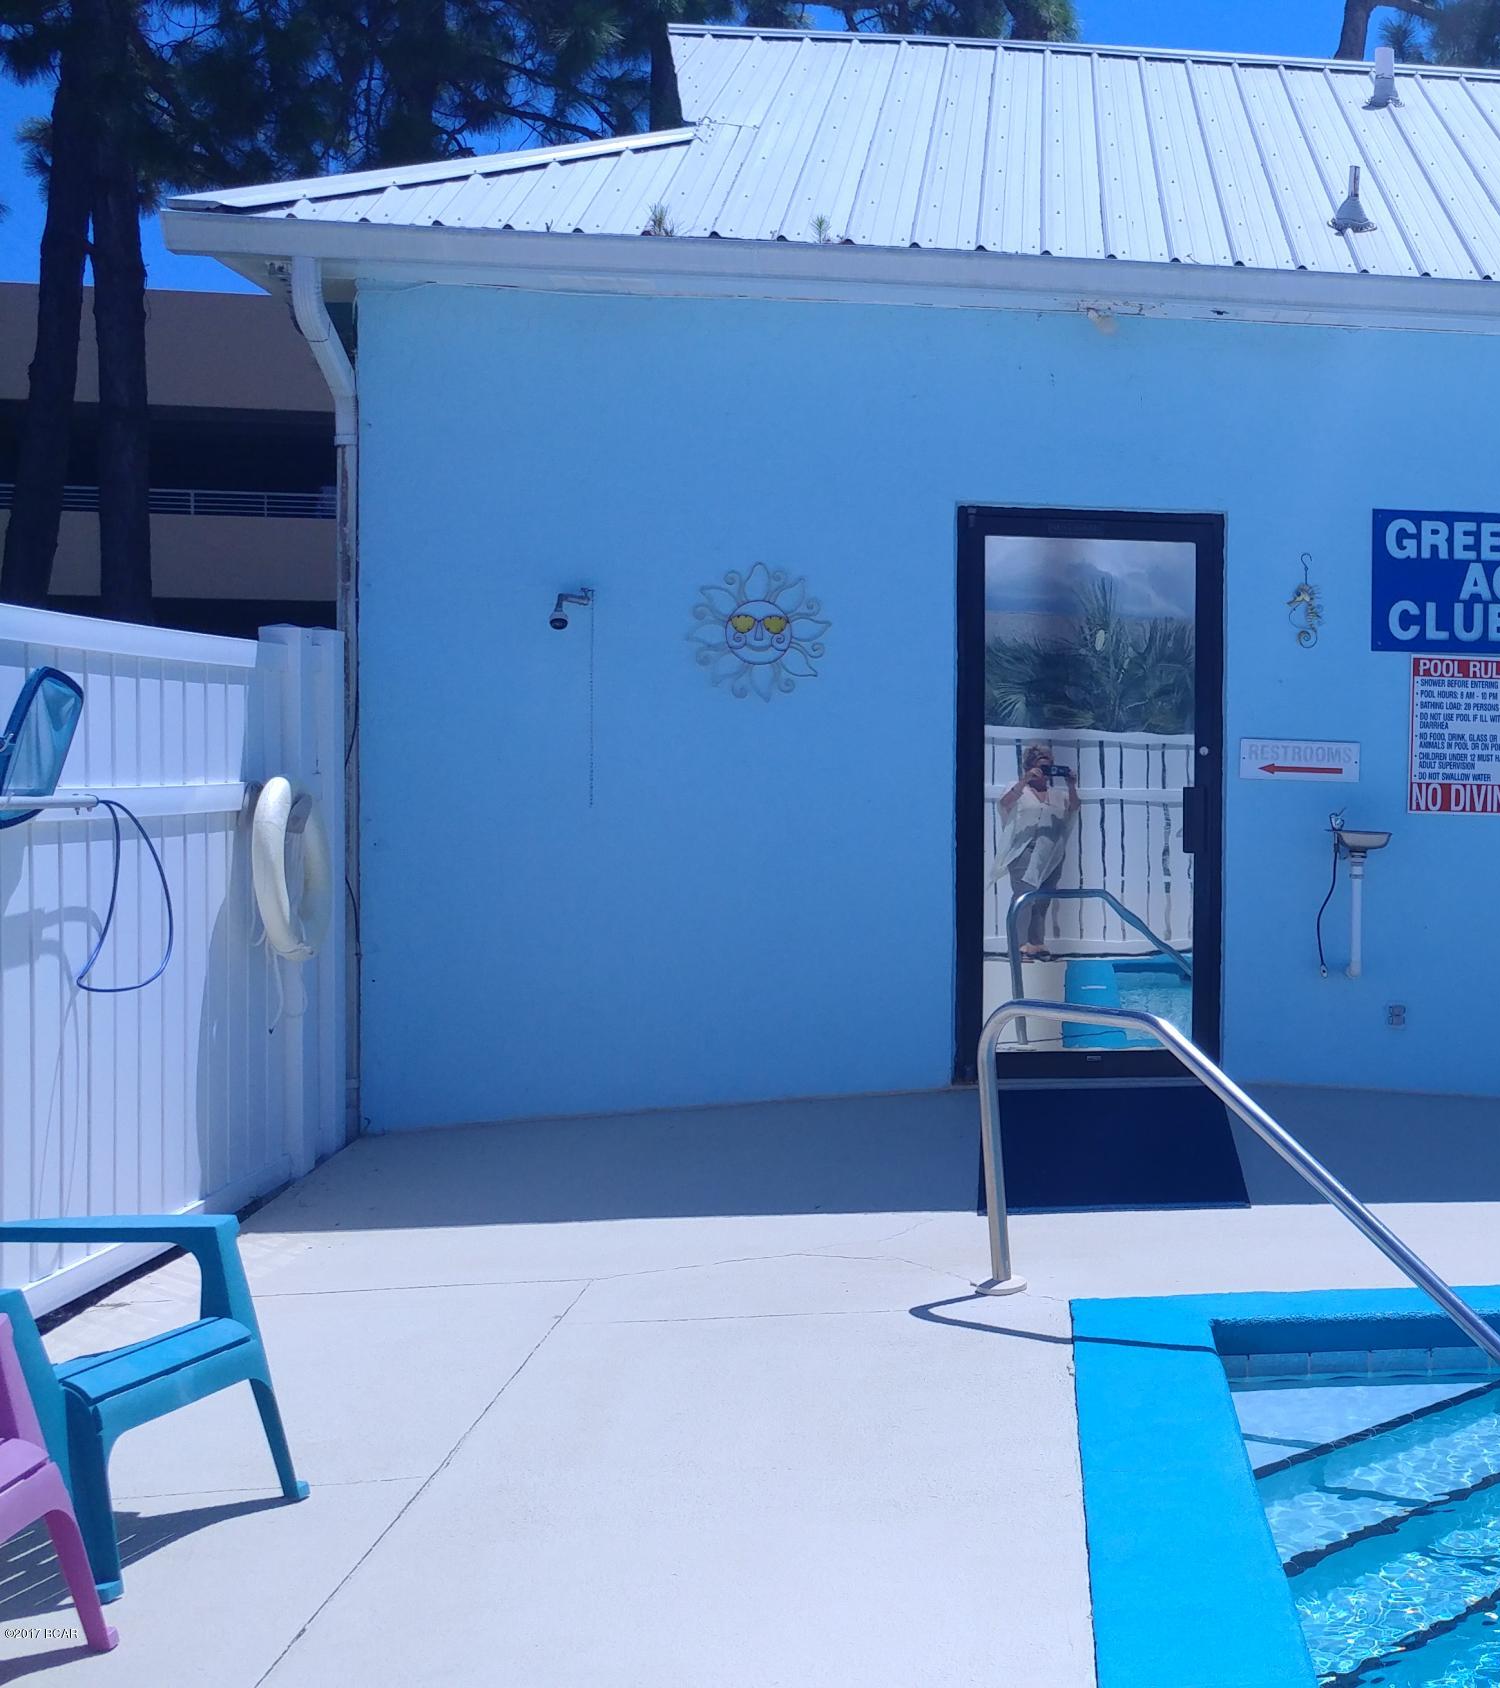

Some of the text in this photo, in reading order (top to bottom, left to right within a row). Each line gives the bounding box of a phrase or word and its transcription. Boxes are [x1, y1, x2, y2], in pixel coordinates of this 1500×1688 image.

[1419, 659, 1463, 677] POOL
[1420, 679, 1499, 690] SHOWER BEFORE ENTERING
[1420, 690, 1436, 698] POOL
[1465, 692, 1475, 700] AM
[1481, 692, 1487, 700] 10
[1488, 692, 1498, 700] PM
[1420, 701, 1500, 711] BATHING LOAD: 20 PERSONS
[1419, 712, 1428, 721] DO
[1429, 713, 1442, 721] NOT
[1443, 713, 1454, 722] USE
[1455, 713, 1471, 722] POOL
[1472, 714, 1478, 722] IF
[1479, 714, 1488, 723] ILL
[1419, 721, 1449, 730] DIARRHEA
[1419, 732, 1428, 741] NO
[1468, 734, 1488, 743] GLASS
[1489, 734, 1498, 743] OR
[1419, 741, 1445, 750] ANIMALS
[1446, 742, 1453, 750] IN
[1454, 742, 1470, 750] POOL
[1471, 743, 1480, 751] OR
[1481, 743, 1490, 751] ON
[1248, 744, 1353, 764] RESTROOMS
[1418, 752, 1448, 761] CHILDREN
[1448, 753, 1468, 762] UNDER
[1469, 754, 1476, 762] 12
[1477, 754, 1494, 763] MUST
[1418, 761, 1476, 771] ADULT SUPERVISION
[1418, 772, 1492, 782] DO NOT SWALLOW WATER
[1411, 782, 1442, 811] NO
